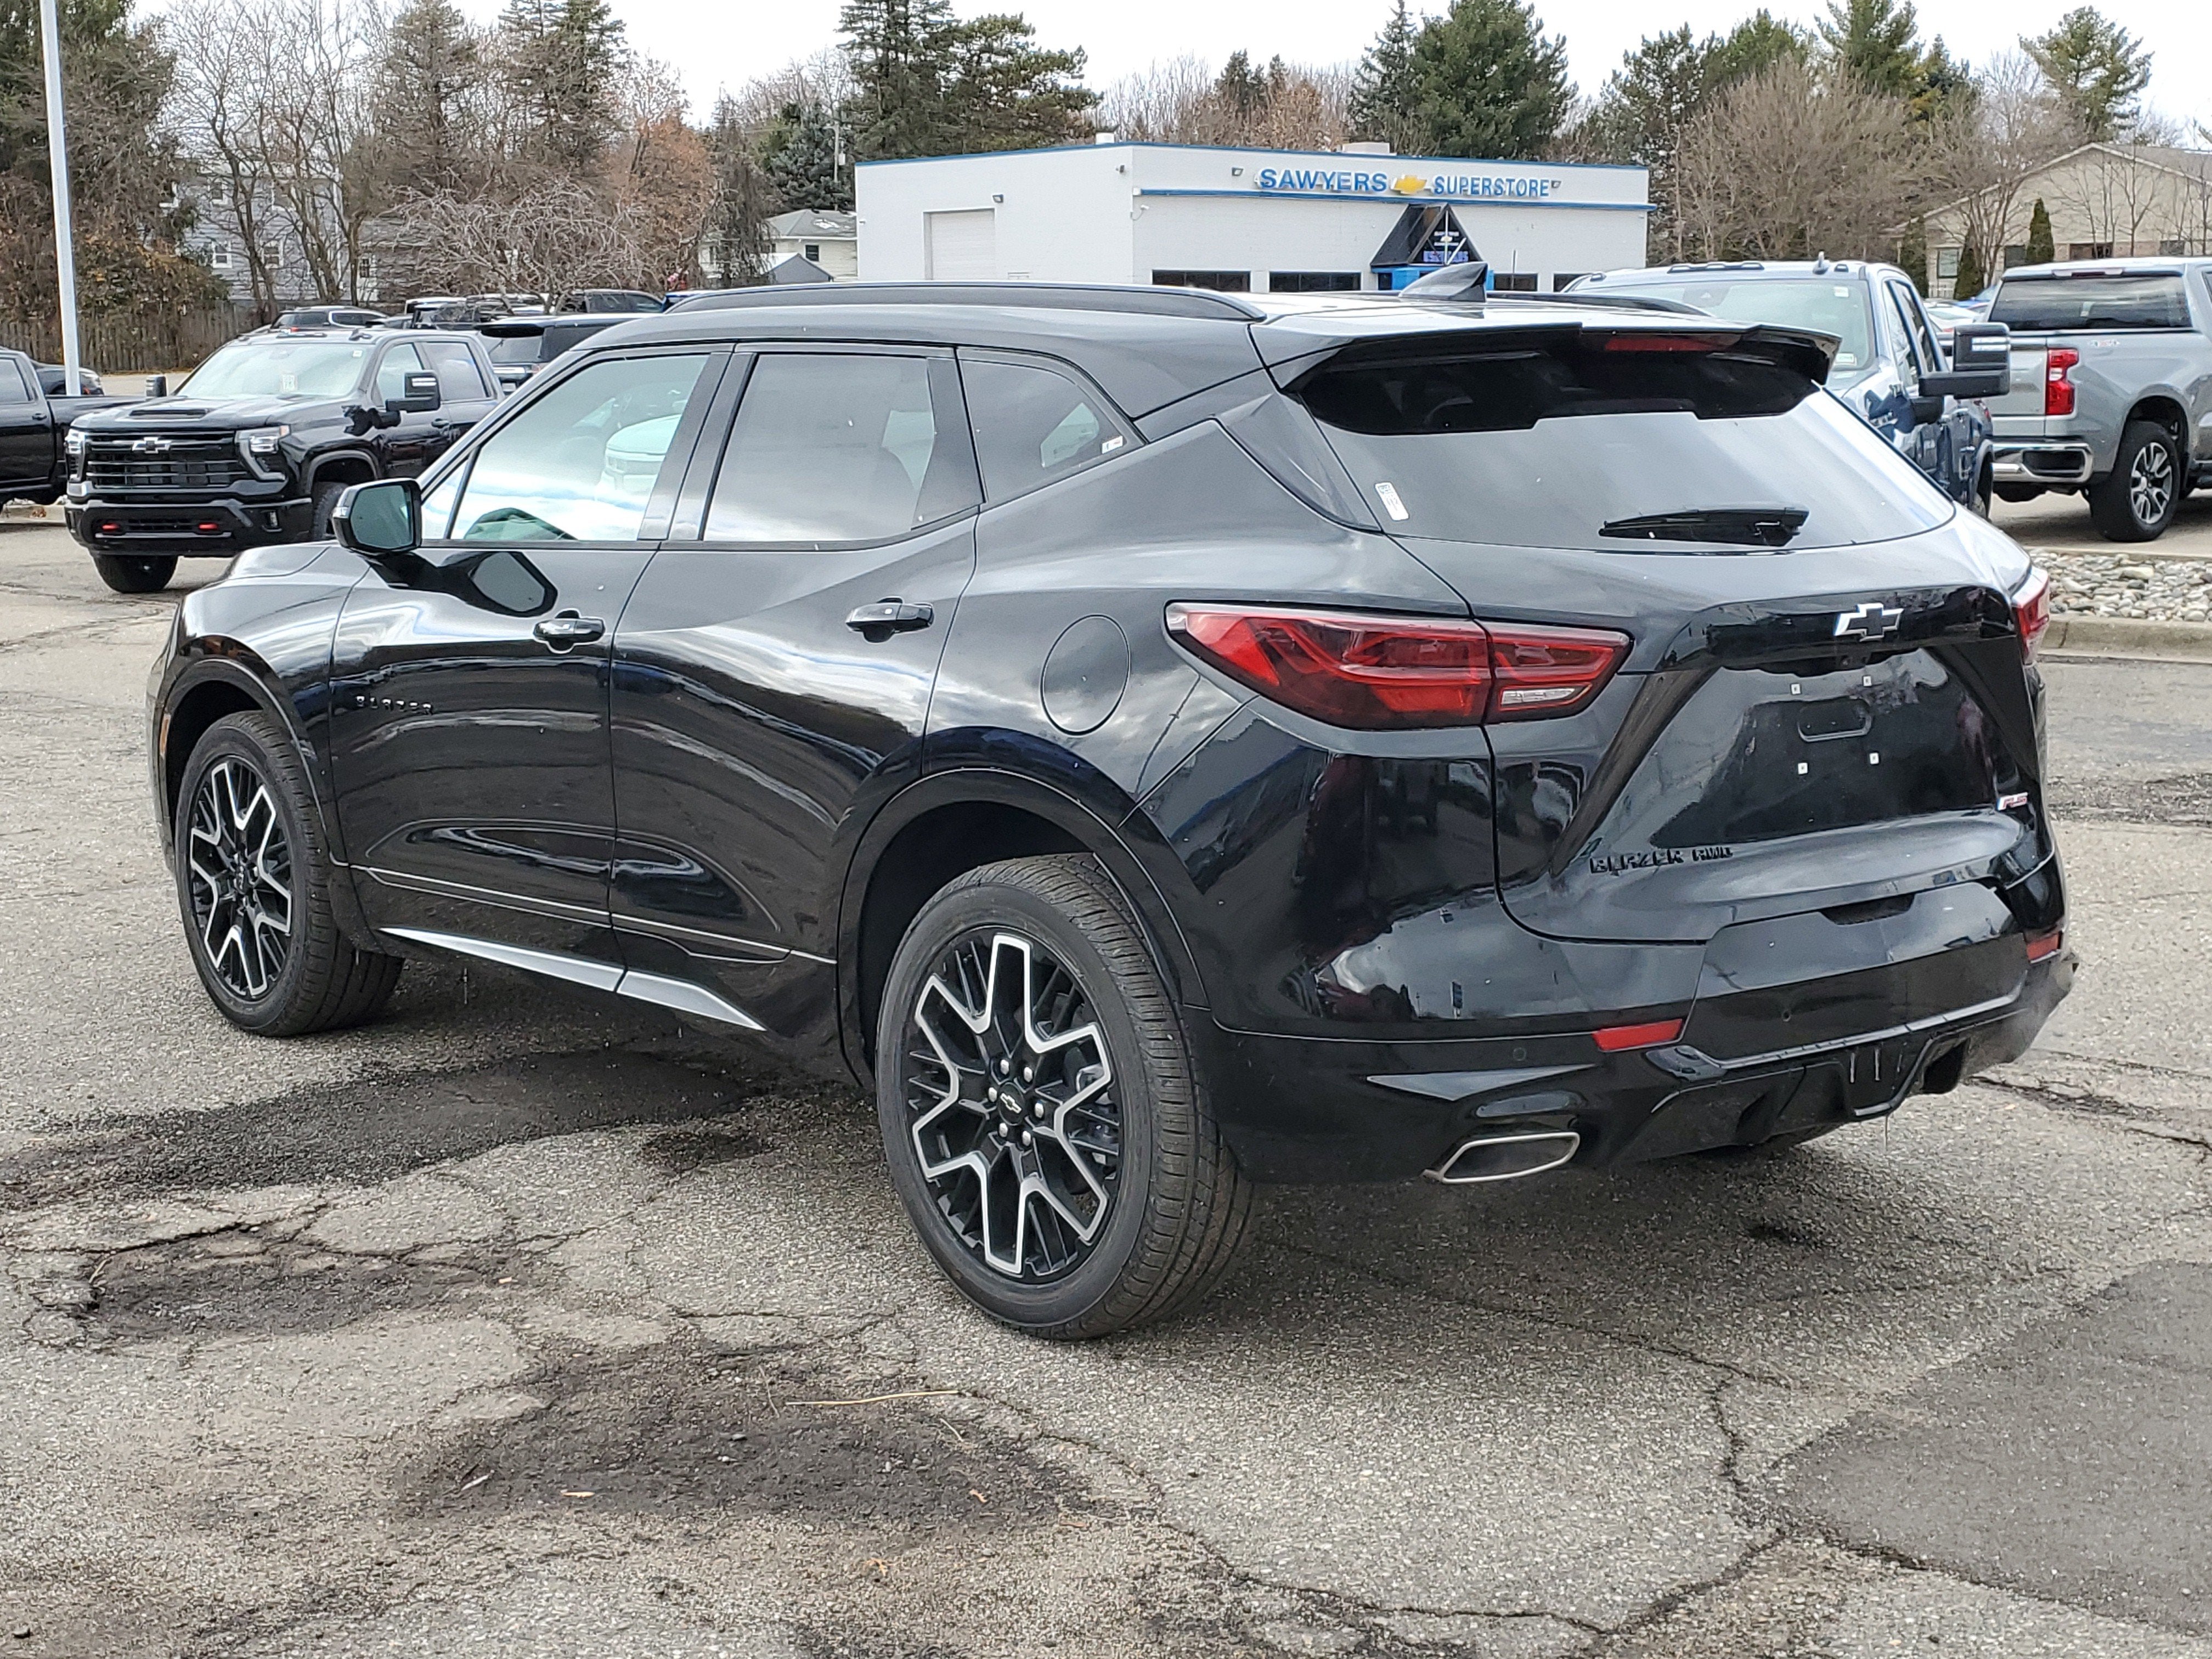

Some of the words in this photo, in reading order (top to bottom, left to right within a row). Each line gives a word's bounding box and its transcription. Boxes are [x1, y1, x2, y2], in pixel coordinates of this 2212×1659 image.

[1260, 168, 1387, 192] SAWYERS
[1434, 176, 1549, 197] SUPERSTORE
[1996, 792, 2028, 811] RS
